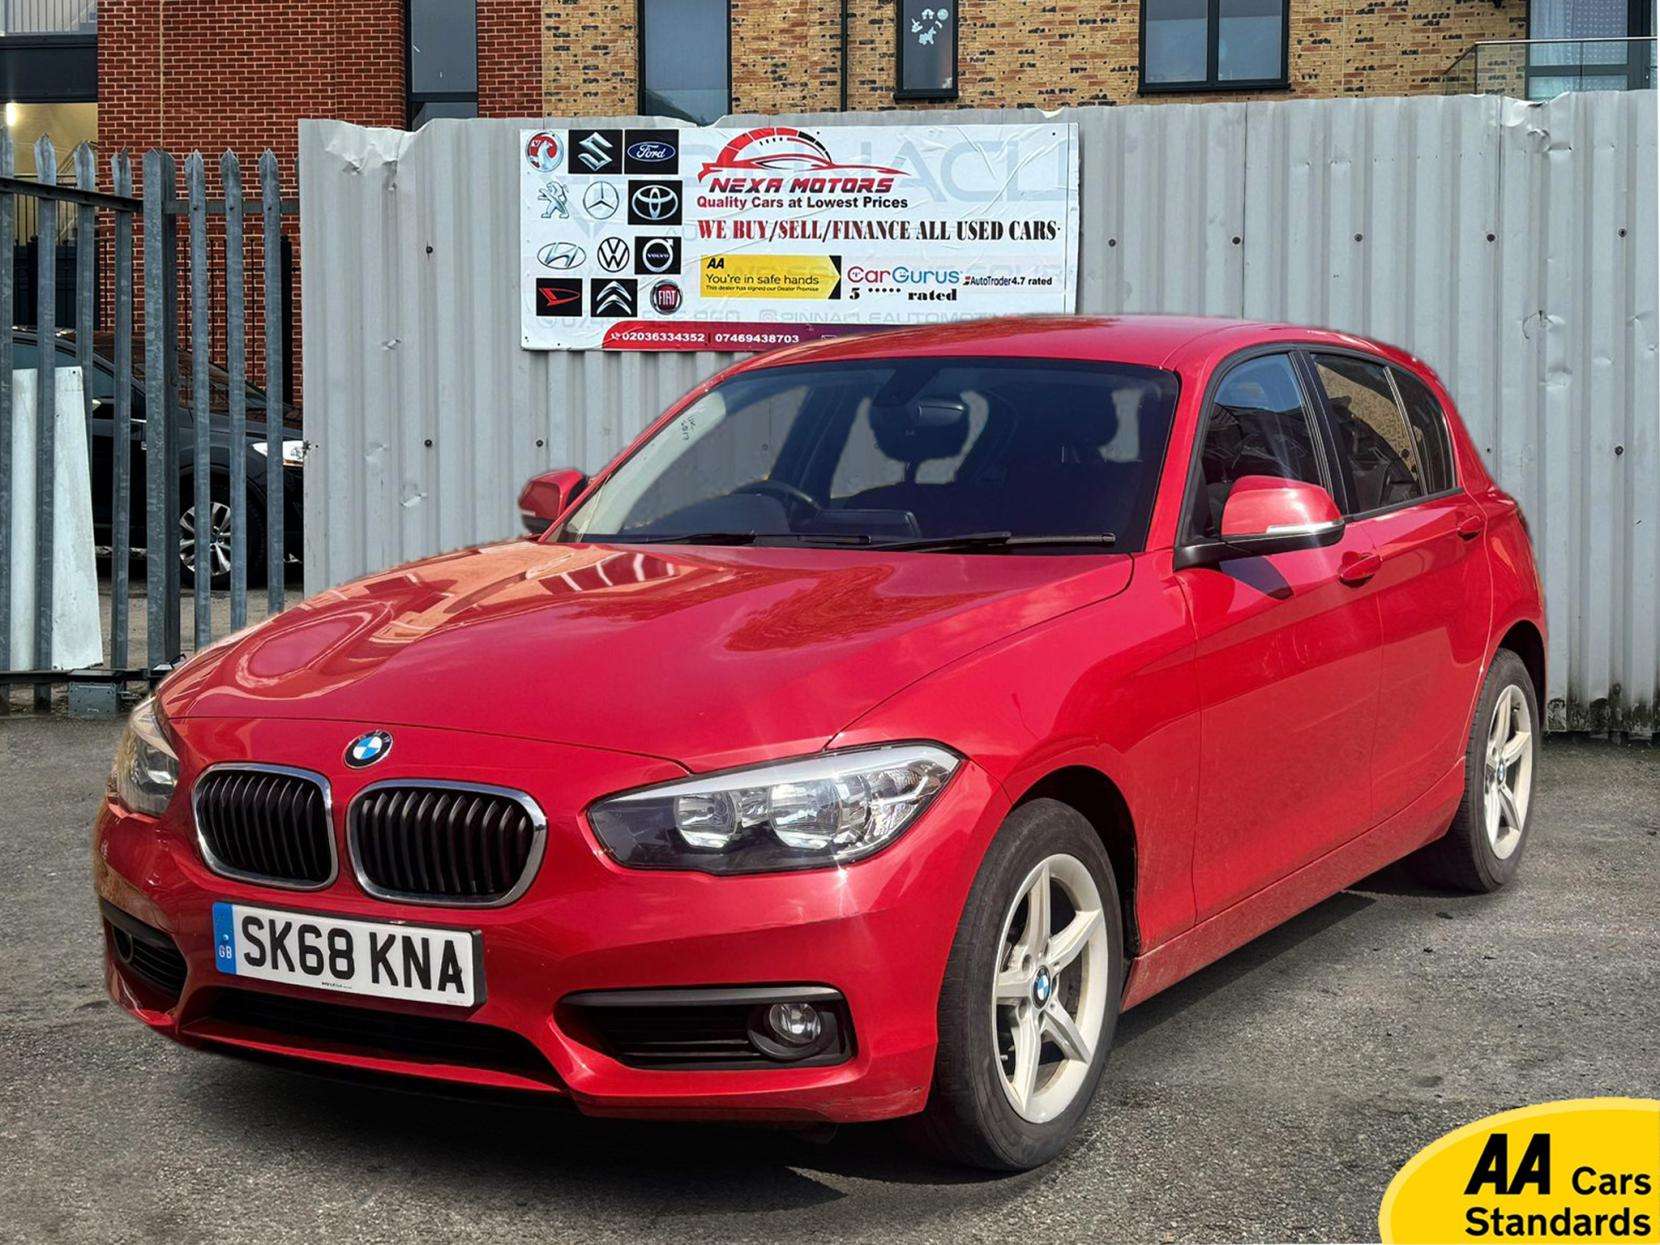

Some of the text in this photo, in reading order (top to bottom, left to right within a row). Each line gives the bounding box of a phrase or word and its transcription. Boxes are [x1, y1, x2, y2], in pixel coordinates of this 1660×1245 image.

[638, 144, 666, 159] Ford
[709, 177, 895, 194] NEXA MOTORS
[697, 195, 908, 211] Quality Cars at Lowest Prices
[697, 219, 727, 240] WE
[916, 220, 951, 241] ALL
[957, 220, 1004, 241] USED
[1009, 220, 1057, 241] CARS
[706, 257, 726, 269] AA
[705, 273, 820, 285] You're in safe hands
[847, 265, 960, 284] CarGurus
[1028, 276, 1053, 286] rated
[657, 289, 677, 306] FIAT
[849, 287, 958, 301] 5 rated
[622, 332, 800, 344] 02036334352 07469438703
[218, 944, 233, 959] GB
[241, 915, 466, 994] SK68 KNA
